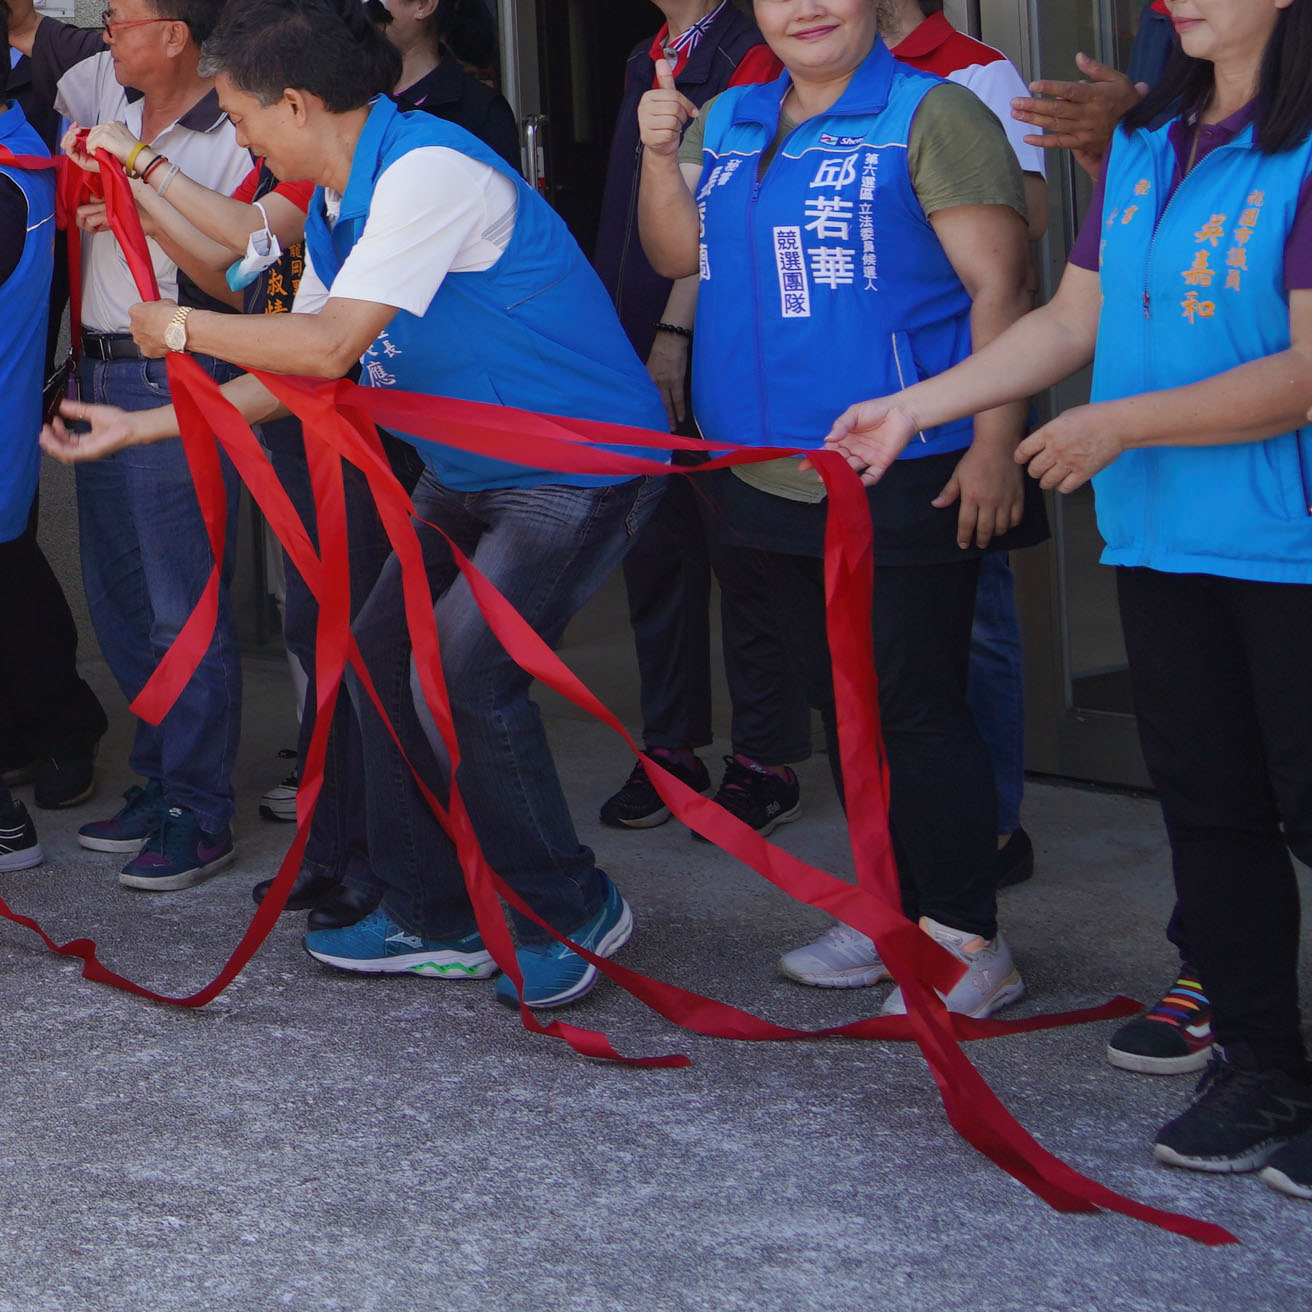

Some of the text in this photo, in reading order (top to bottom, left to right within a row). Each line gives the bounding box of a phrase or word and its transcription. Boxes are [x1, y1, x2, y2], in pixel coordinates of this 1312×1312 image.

[776, 229, 807, 316] 競選團隊
[804, 152, 859, 290] 邱若華
[1180, 213, 1226, 325] 吳嘉和
[1223, 189, 1265, 292] 桃園市議員
